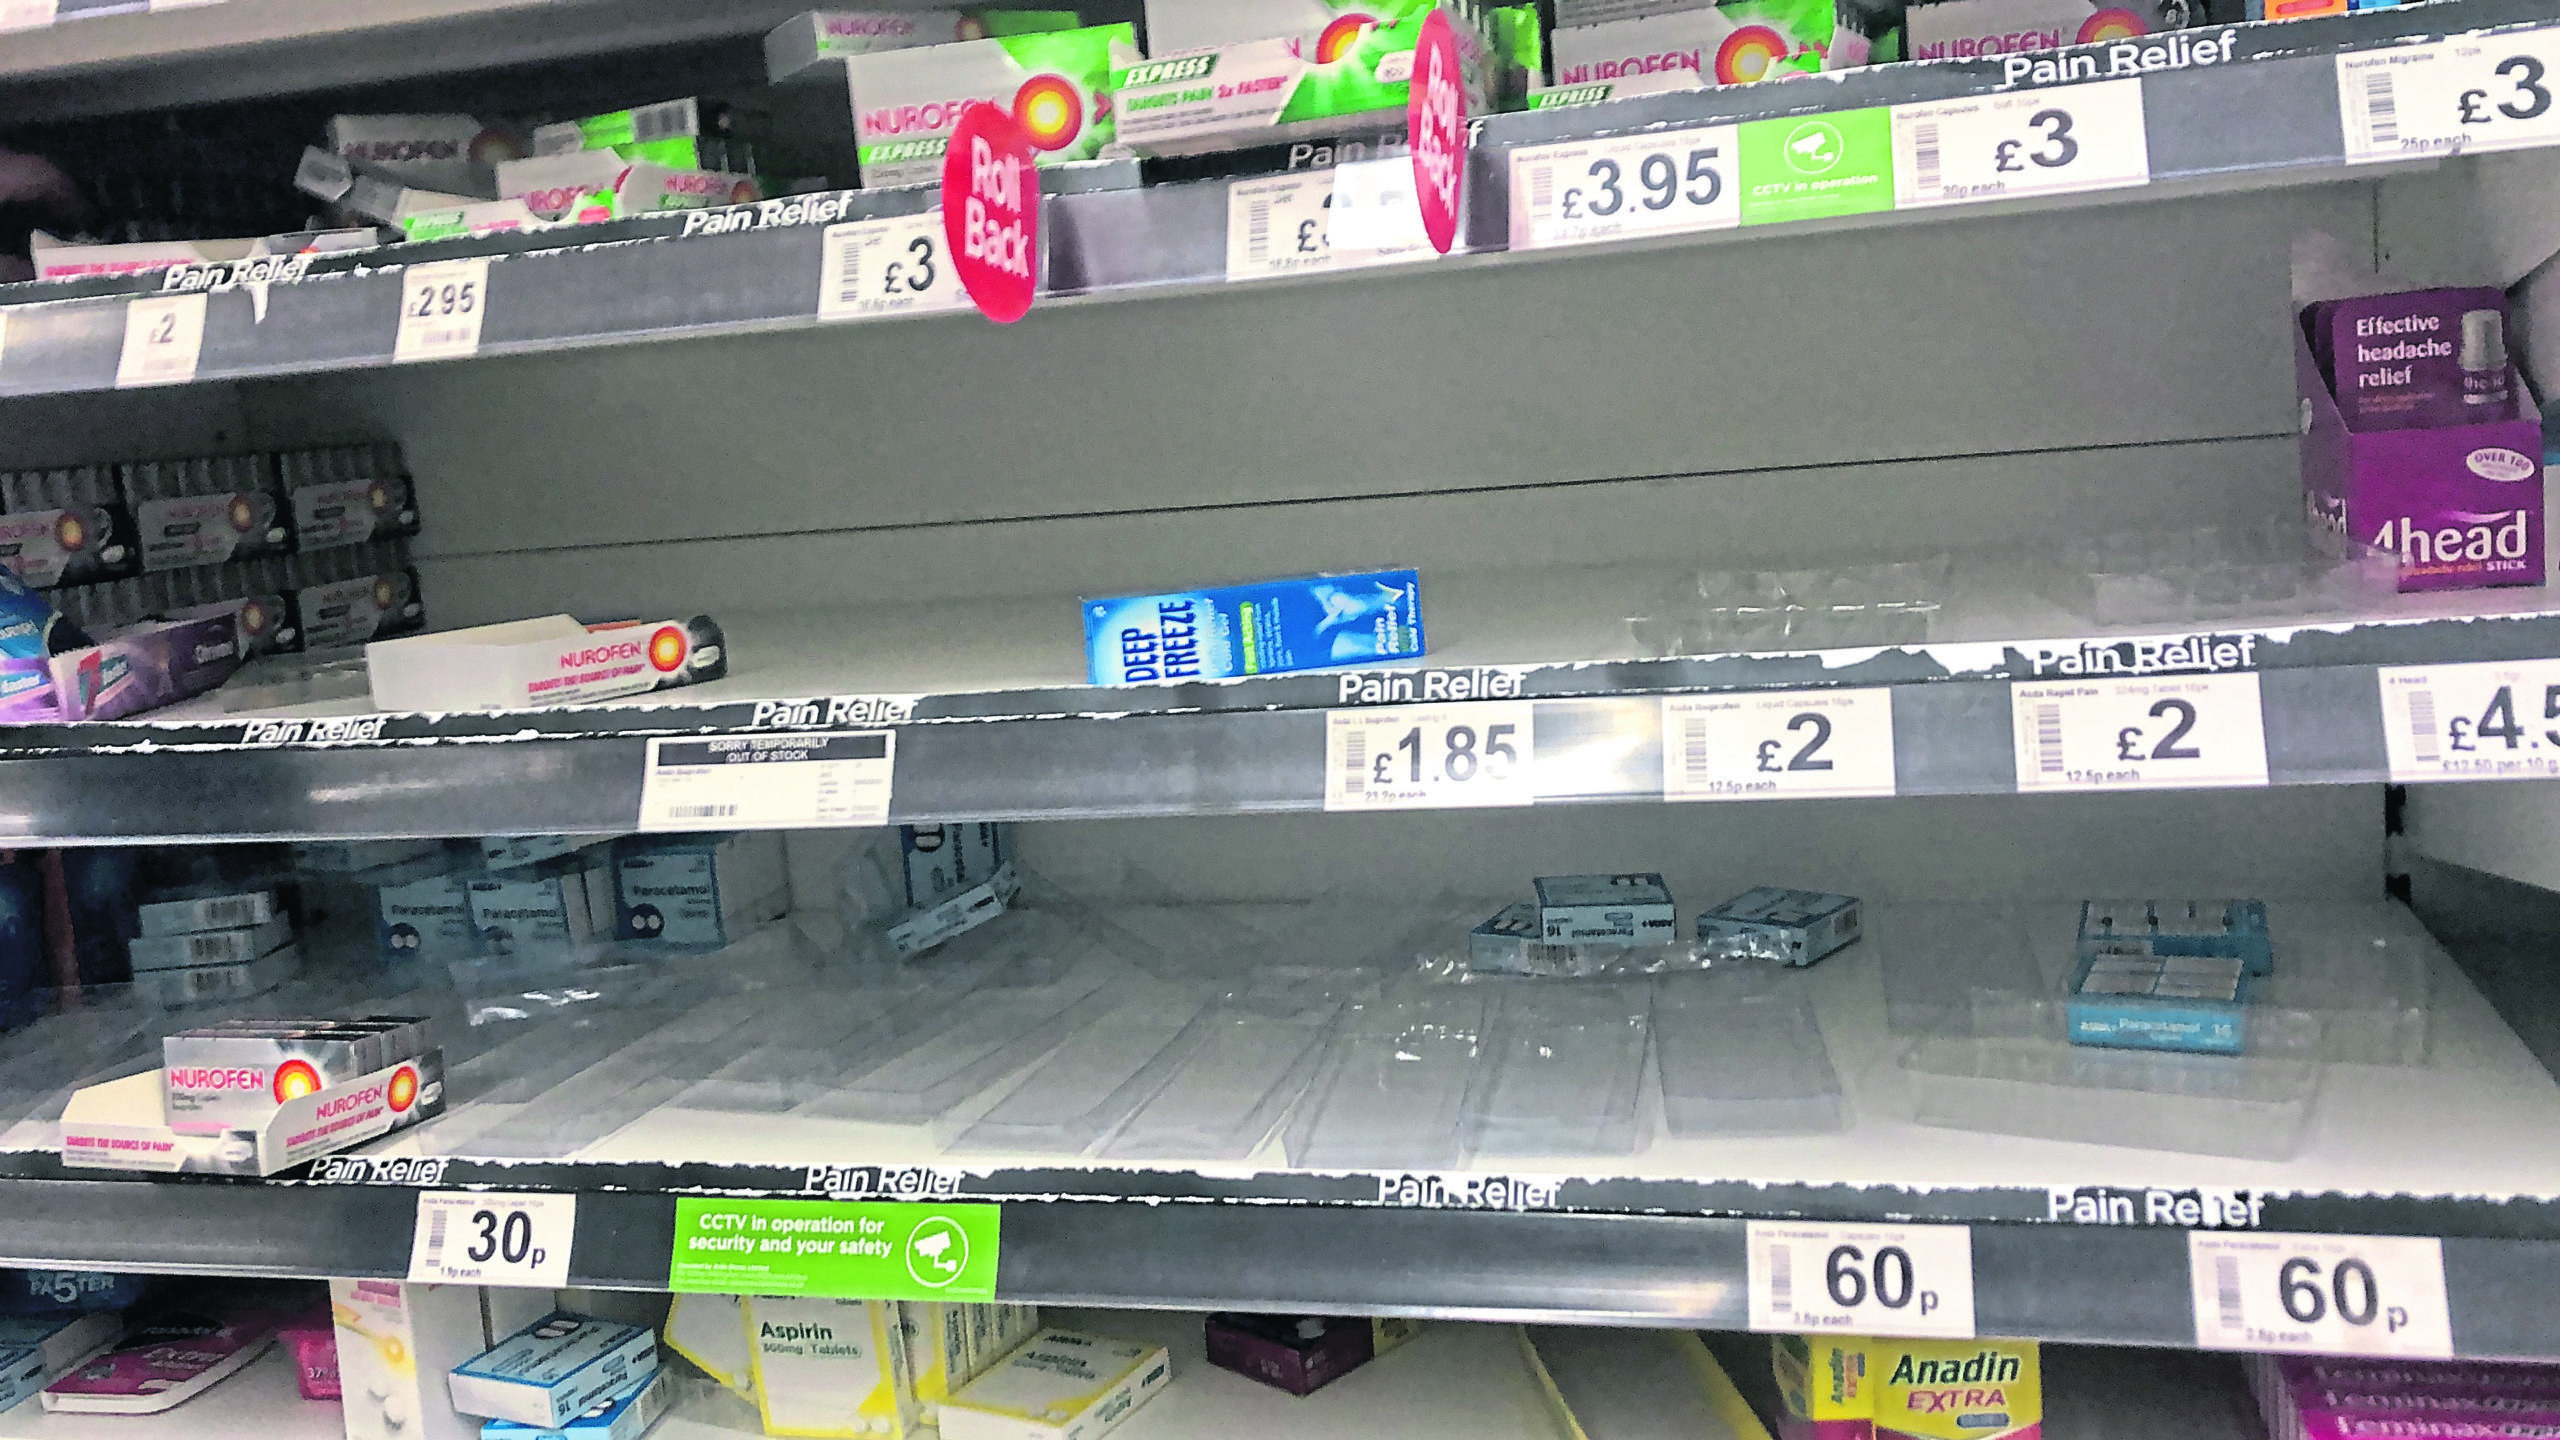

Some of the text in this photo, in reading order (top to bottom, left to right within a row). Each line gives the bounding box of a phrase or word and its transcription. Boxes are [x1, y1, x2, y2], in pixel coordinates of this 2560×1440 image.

[1124, 56, 1211, 87] EXPRESS
[2003, 30, 2237, 88] Pain Relief
[2458, 55, 2552, 124] £3
[865, 97, 996, 137] NUROF
[869, 139, 948, 161] EXPRESS
[1995, 109, 2079, 172] £3
[2401, 133, 2472, 152] 25p each
[971, 134, 1023, 212] Roll
[1562, 147, 1722, 219] £3.95
[1752, 174, 1878, 197] CCTV in operation
[683, 191, 853, 235] Pain Relief
[965, 196, 1029, 279] Back
[163, 264, 231, 291] Pain
[232, 254, 314, 286] Relief
[885, 235, 935, 294] £3
[149, 313, 177, 345] £2
[2356, 313, 2440, 337] Effective
[2357, 338, 2452, 363] headache
[2358, 365, 2413, 389] relief
[2373, 510, 2528, 563] 4head
[2486, 559, 2528, 571] STICK
[1159, 599, 1201, 679] FREEZE
[1375, 617, 1387, 654] Pain
[1385, 604, 1399, 653] Relief
[561, 641, 642, 669] NUROFEN
[1121, 627, 1160, 683] DEEP
[2032, 634, 2257, 676] Pain Relief
[1338, 670, 1527, 703] Pain Relief
[2019, 689, 2044, 698] Asda
[2077, 687, 2098, 697] Pain
[751, 698, 919, 727] Pain Relief
[242, 715, 387, 744] Pain Relief
[708, 738, 831, 753] SORRY TEMPORARILY
[1756, 712, 1833, 772] £2
[2116, 698, 2201, 761] £2
[726, 750, 809, 762] OUT OF STOCK
[1373, 724, 1517, 784] £1.85
[1746, 780, 1777, 792] each
[2106, 769, 2140, 781] each
[171, 1068, 264, 1090] NUROFEN
[316, 1084, 383, 1120] NUROFEN
[309, 1158, 450, 1183] Pain Relief
[805, 1167, 966, 1195] Pain Relief
[1378, 1175, 1561, 1209] Pain Relief
[2047, 1190, 2134, 1224] Pain
[468, 1209, 546, 1269] 30p
[700, 1213, 884, 1234] CCTV in operation for
[689, 1234, 892, 1258] security and your safety
[1827, 1244, 1939, 1315] 60p
[2280, 1256, 2408, 1333] 60p
[761, 1321, 833, 1341] Aspirin
[1889, 1352, 2020, 1385] Anadin
[1907, 1389, 2007, 1413] EXTRA
